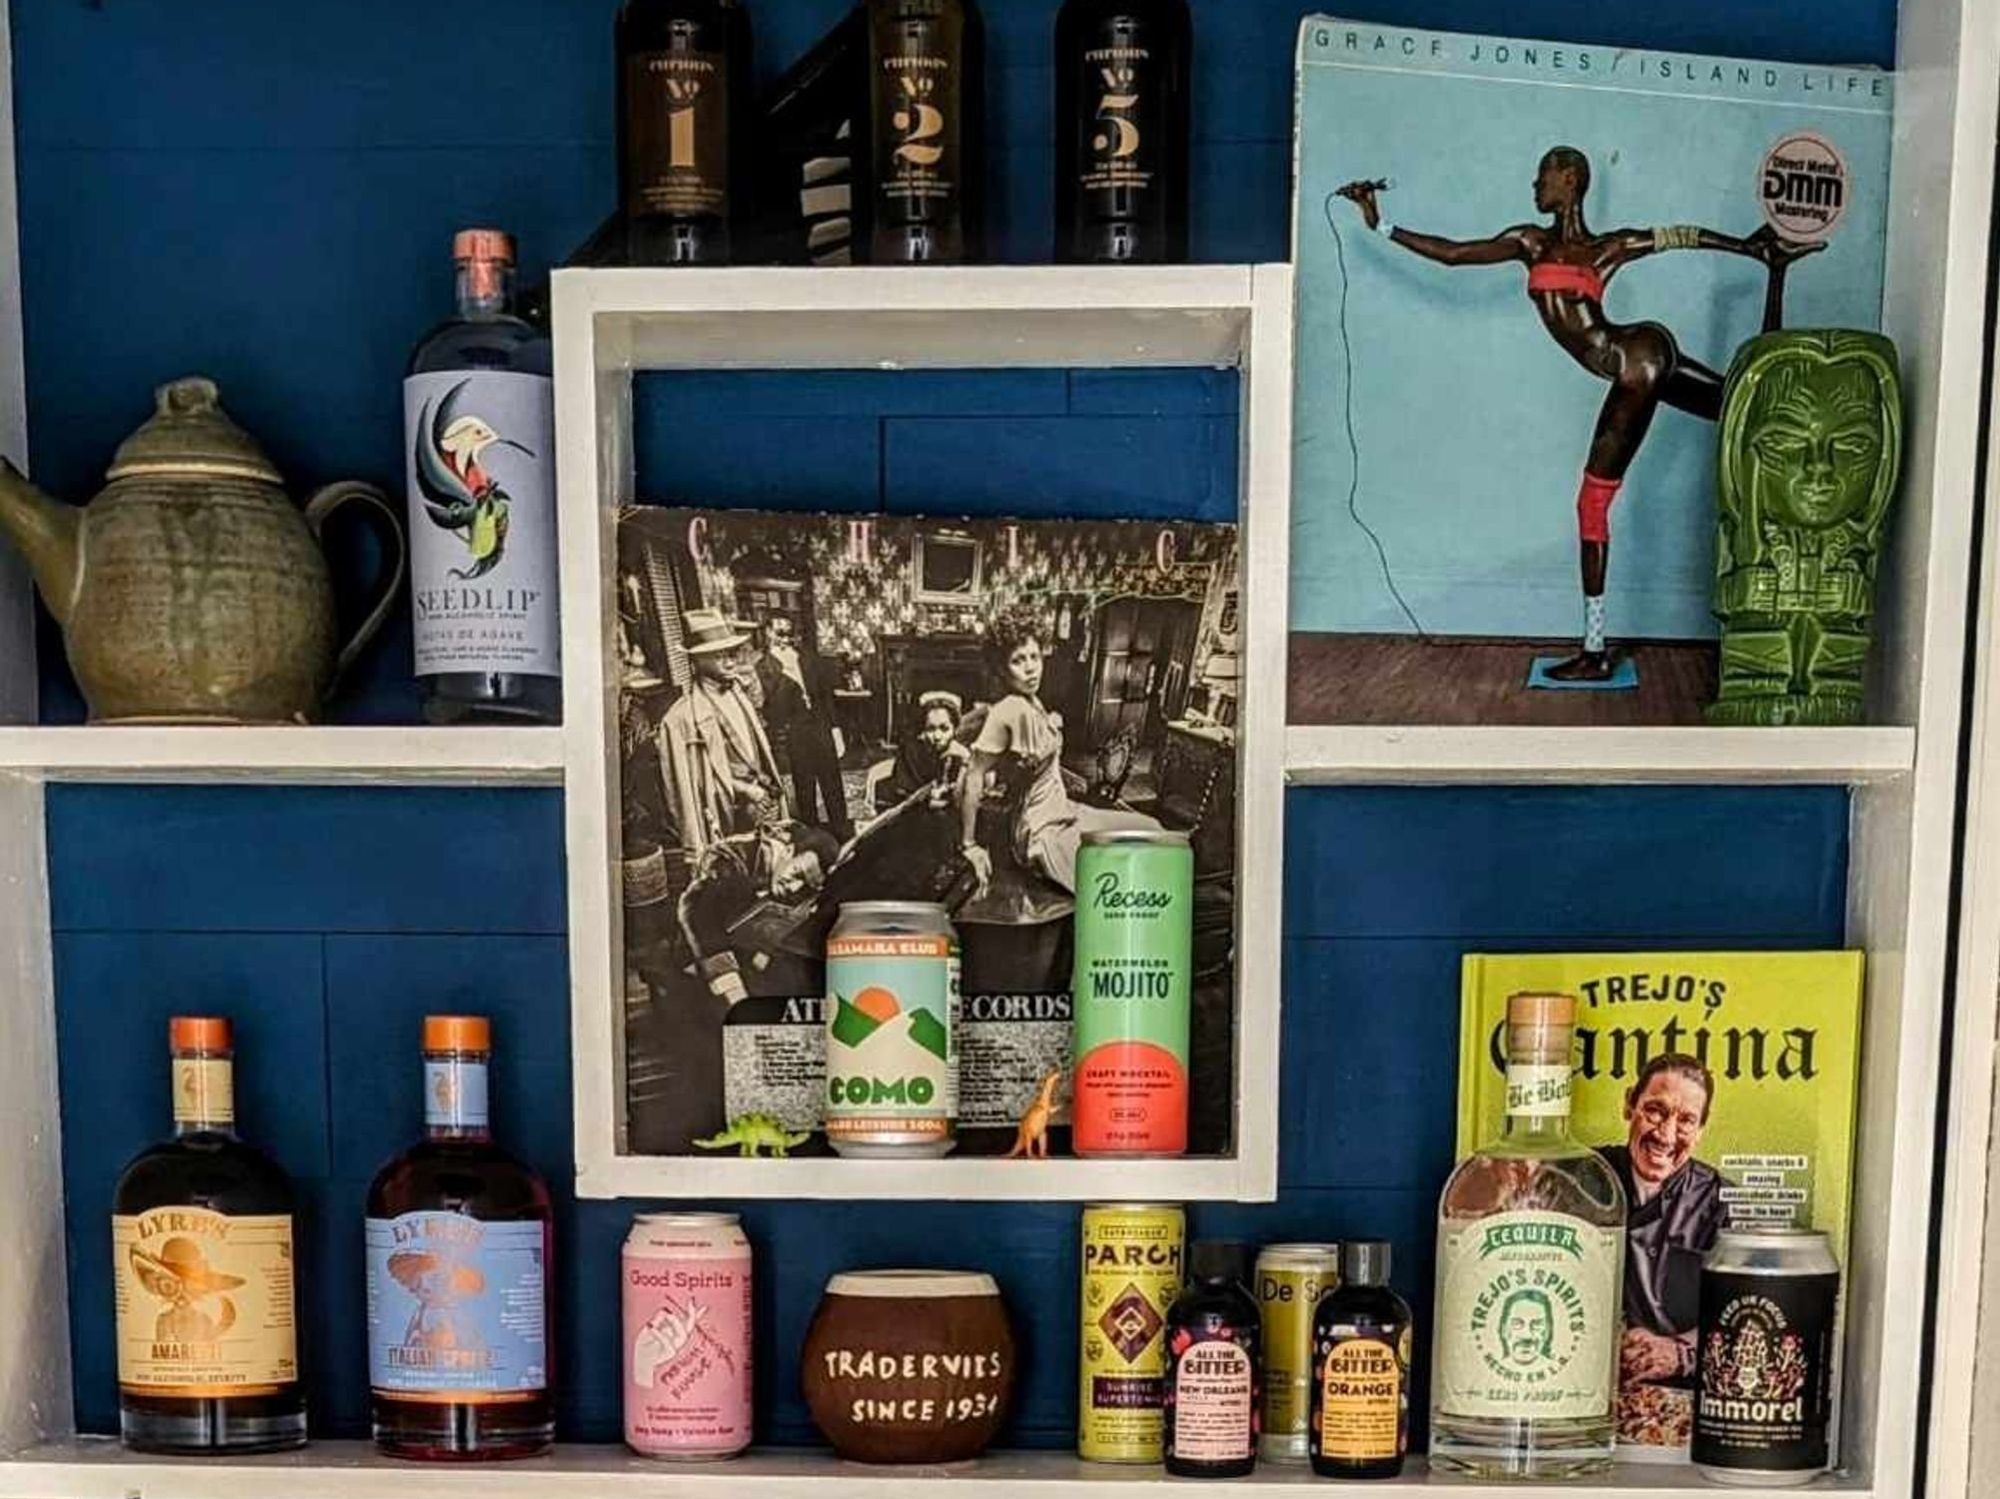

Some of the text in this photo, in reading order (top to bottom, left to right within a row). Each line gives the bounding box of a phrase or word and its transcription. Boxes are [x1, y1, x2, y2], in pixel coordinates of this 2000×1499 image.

[1470, 43, 1590, 71] JONES
[1639, 59, 1777, 88] ISLAND
[1803, 73, 1883, 97] LIFE
[670, 107, 695, 167] 1
[893, 103, 944, 165] 2
[1093, 94, 1139, 156] 5
[416, 589, 536, 620] SEEDLIP
[1093, 871, 1172, 909] Recess
[1092, 959, 1168, 968] WATERMELON
[1580, 973, 1726, 1008] TREJO'S
[960, 995, 1071, 1020] ECORDS
[1489, 1010, 1819, 1081] antina
[829, 1075, 934, 1105] COMO
[1490, 1226, 1574, 1247] TEQUILA
[1085, 1244, 1181, 1275] PARCH
[630, 1269, 733, 1291] Good Spirits
[1263, 1278, 1294, 1302] De
[1471, 1268, 1586, 1333] TREJO'S SPIRITS
[1185, 1359, 1245, 1375] BITTER
[1331, 1358, 1393, 1374] BITTER
[1327, 1382, 1394, 1396] ORANGE
[852, 1399, 936, 1422] SINCE
